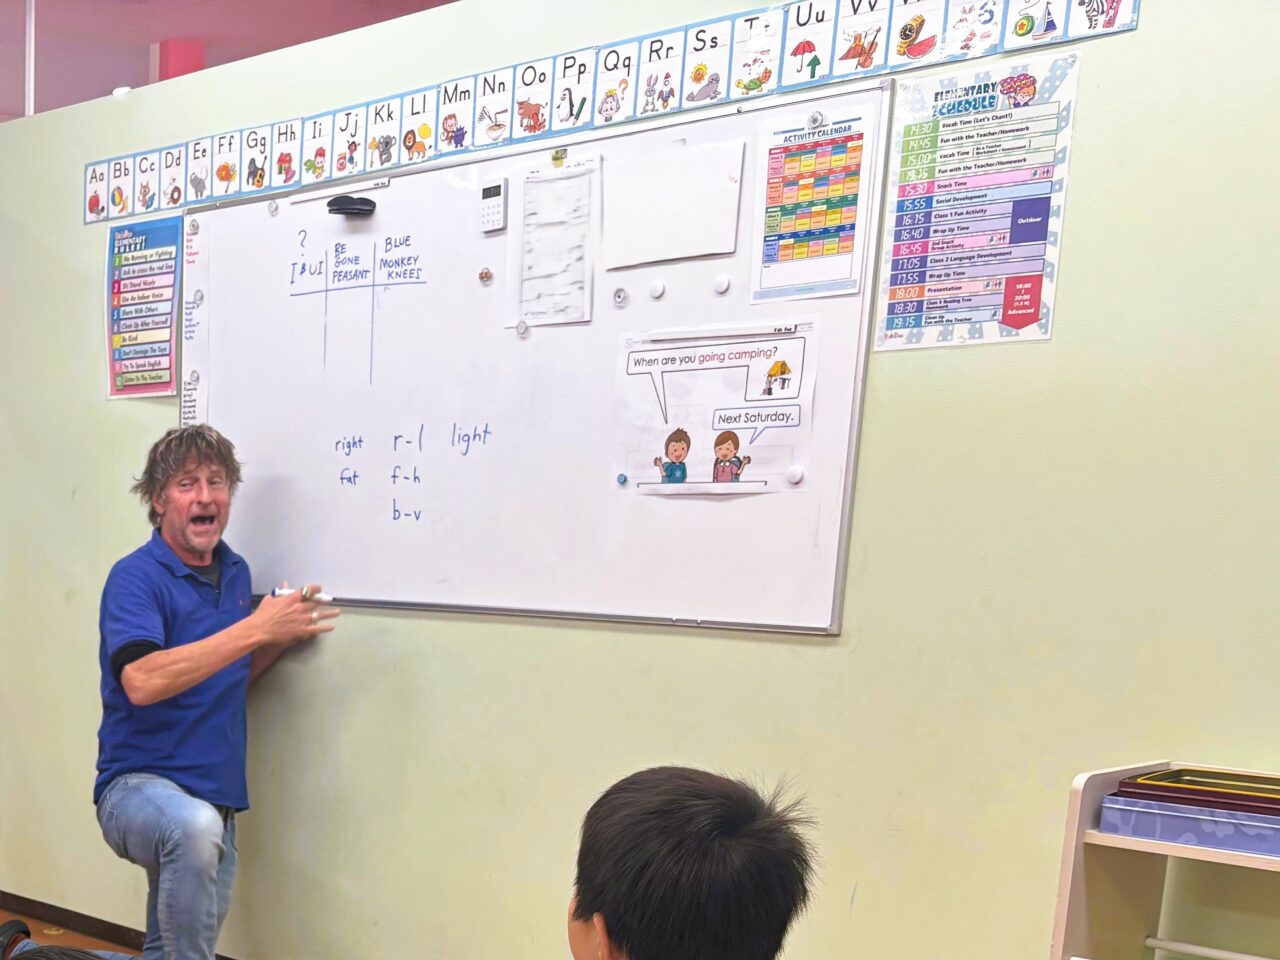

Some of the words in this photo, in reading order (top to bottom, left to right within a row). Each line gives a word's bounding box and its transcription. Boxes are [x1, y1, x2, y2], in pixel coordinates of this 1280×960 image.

[89, 168, 104, 184] Aa
[113, 162, 130, 179] Bb
[138, 157, 155, 173] Cc
[165, 151, 181, 169] Dd
[193, 142, 207, 160] Ee
[218, 135, 235, 154] Ff
[246, 131, 266, 154] Gg
[277, 123, 296, 144] Hh
[312, 121, 322, 139] Ii
[339, 112, 359, 137] Jj
[374, 103, 394, 124] Kk
[443, 83, 470, 105] Mm
[482, 74, 506, 96] Nn
[521, 65, 547, 87] Oo
[562, 56, 587, 85] Pp
[604, 50, 632, 77] Qq
[649, 39, 674, 63] Rr
[693, 29, 718, 52] Ss
[796, 2, 825, 27] Uu
[942, 121, 958, 129] Vocab
[960, 118, 972, 126] Time
[783, 131, 816, 144] ACTIVITY
[817, 124, 852, 138] CALENDAR
[903, 199, 926, 211] 15:55
[902, 213, 925, 226] 16:15
[934, 212, 949, 220] Class
[964, 208, 988, 216] Activity
[901, 229, 924, 242] 16:40
[384, 235, 412, 253] BLUE
[334, 256, 360, 268] GONE
[379, 255, 419, 271] MONKEY
[332, 268, 371, 284] PEASANT
[387, 267, 422, 280] KNEES
[927, 285, 962, 293] Presentation
[894, 302, 917, 315] 18:30
[633, 357, 659, 367] When
[661, 356, 677, 365] are
[678, 355, 696, 369] you
[698, 351, 726, 364] going
[728, 346, 778, 361] camping?
[718, 413, 742, 424] Next
[744, 410, 794, 424] Saturday.
[335, 436, 364, 456] right
[451, 422, 492, 456] light
[339, 467, 360, 486] fat
